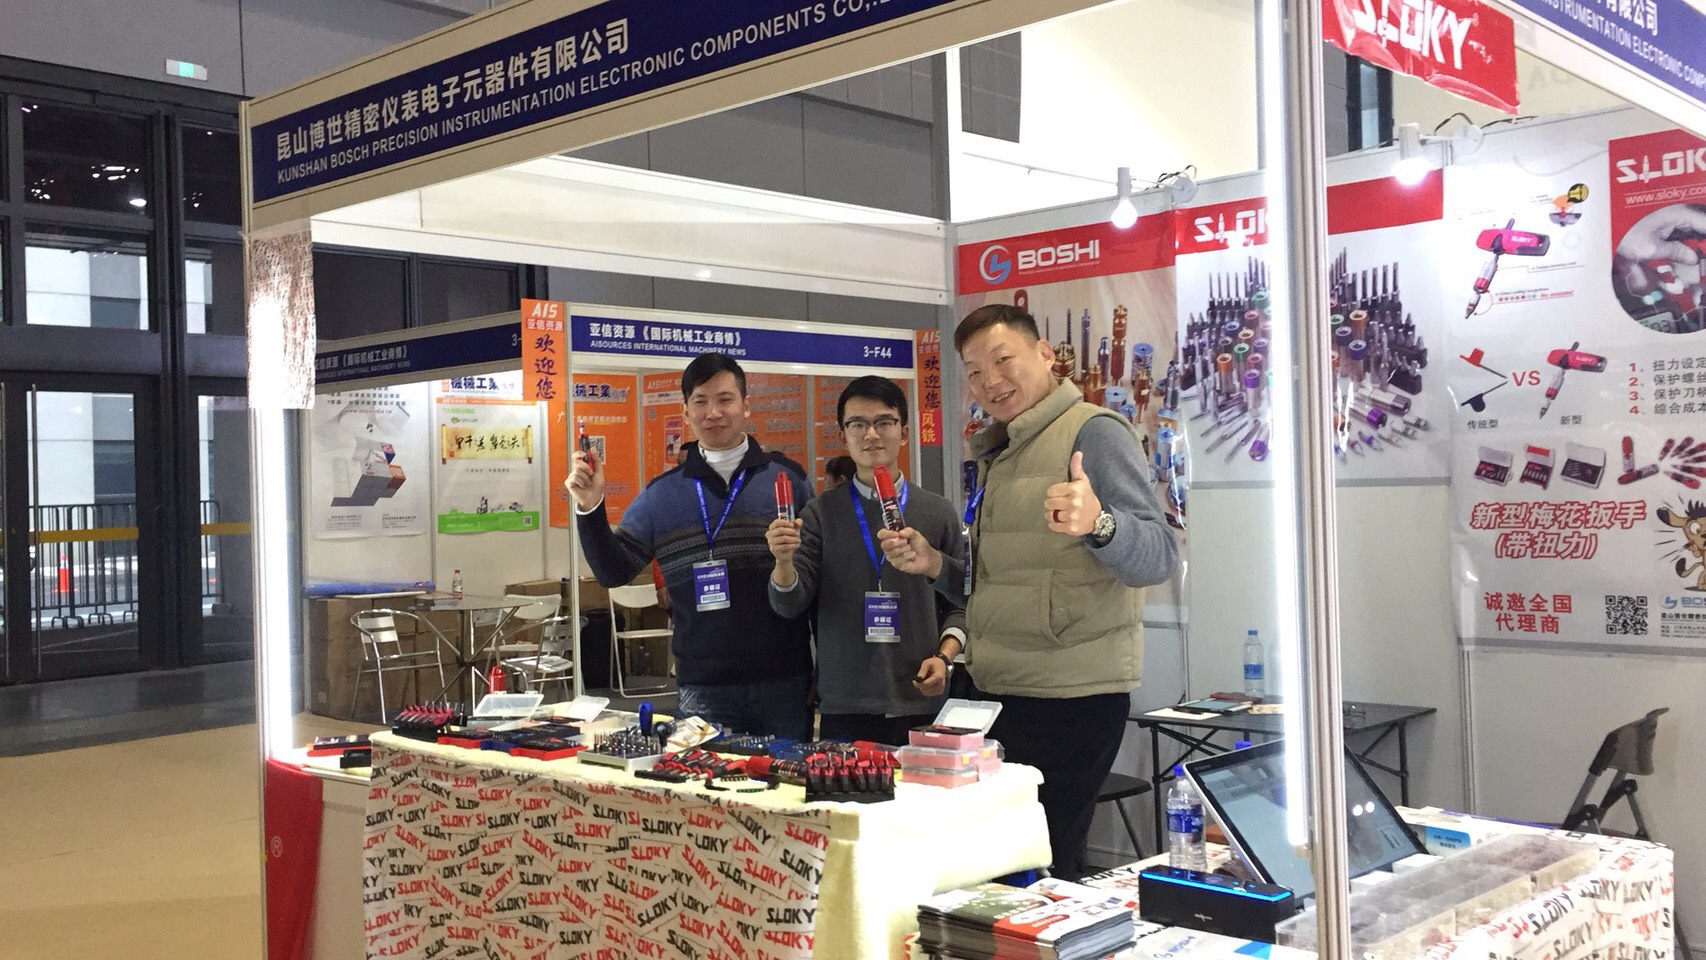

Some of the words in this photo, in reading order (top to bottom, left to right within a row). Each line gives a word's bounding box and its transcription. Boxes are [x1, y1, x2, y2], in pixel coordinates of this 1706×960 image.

[277, 18, 628, 161] 昆山博世精密仪表电子元器件有限公司
[278, 156, 328, 184] KUNSHAN
[330, 143, 370, 168] BOSCH
[372, 122, 438, 156] PRECISION
[441, 80, 576, 136] INSTRUMENTATION
[580, 47, 685, 95] ELECTRONIC
[690, 3, 827, 61] COMPONENTS
[1017, 239, 1100, 270] BOSHI
[531, 302, 559, 319] AIS
[589, 323, 636, 339] 亚信资源
[642, 325, 742, 346] 《国际机械工业商情》
[590, 340, 633, 350] AISOURCES
[633, 342, 688, 353] INTERNATIONAL
[727, 348, 747, 356] NEWS
[863, 346, 892, 359] 3-F44
[534, 333, 558, 399] 欢迎您
[1512, 370, 1541, 387] VS
[1467, 419, 1499, 430] 传统型
[1560, 415, 1583, 426] 新型
[1470, 500, 1647, 530] 新型梅花扳手
[1495, 532, 1599, 560] (带扭力)
[1484, 592, 1573, 614] 诚邀全国
[1495, 614, 1560, 634] 代理商
[421, 779, 453, 800] SLOKY
[478, 789, 512, 801] SLOKY
[553, 779, 590, 808] SLOKY
[366, 808, 395, 827] SLOKY
[440, 814, 472, 827] SLOKY
[487, 811, 520, 829] SLOKY
[642, 818, 683, 836] SLOKY
[728, 809, 771, 846] SLOKY
[395, 824, 427, 849] SLOKY
[575, 822, 612, 839] SLOKY
[784, 821, 829, 851] SLOKY
[482, 836, 514, 857] SLOKY
[522, 829, 557, 861] SLOKY
[631, 845, 671, 860] SLOKY
[389, 864, 424, 876] SLOKY
[682, 844, 719, 890] SLOKY
[744, 857, 788, 889] SLOKY
[780, 848, 823, 885] SLOKY
[397, 879, 430, 895] SLOKY
[485, 867, 513, 901] SLOKY
[519, 871, 553, 886] SLOKY
[430, 874, 462, 909] SLOKY
[528, 891, 560, 906] SLOKY
[562, 884, 597, 919] SLOKY
[495, 896, 527, 912] SLOKY
[637, 892, 678, 928] SLOKY
[1528, 892, 1574, 935] SLOKY
[679, 913, 715, 940] SLOKY
[766, 907, 816, 926] SLOKY
[447, 926, 480, 941] SLOKY
[559, 930, 593, 946] SLOKY
[1553, 920, 1592, 960] SLOKY
[379, 933, 420, 956] SLOKY
